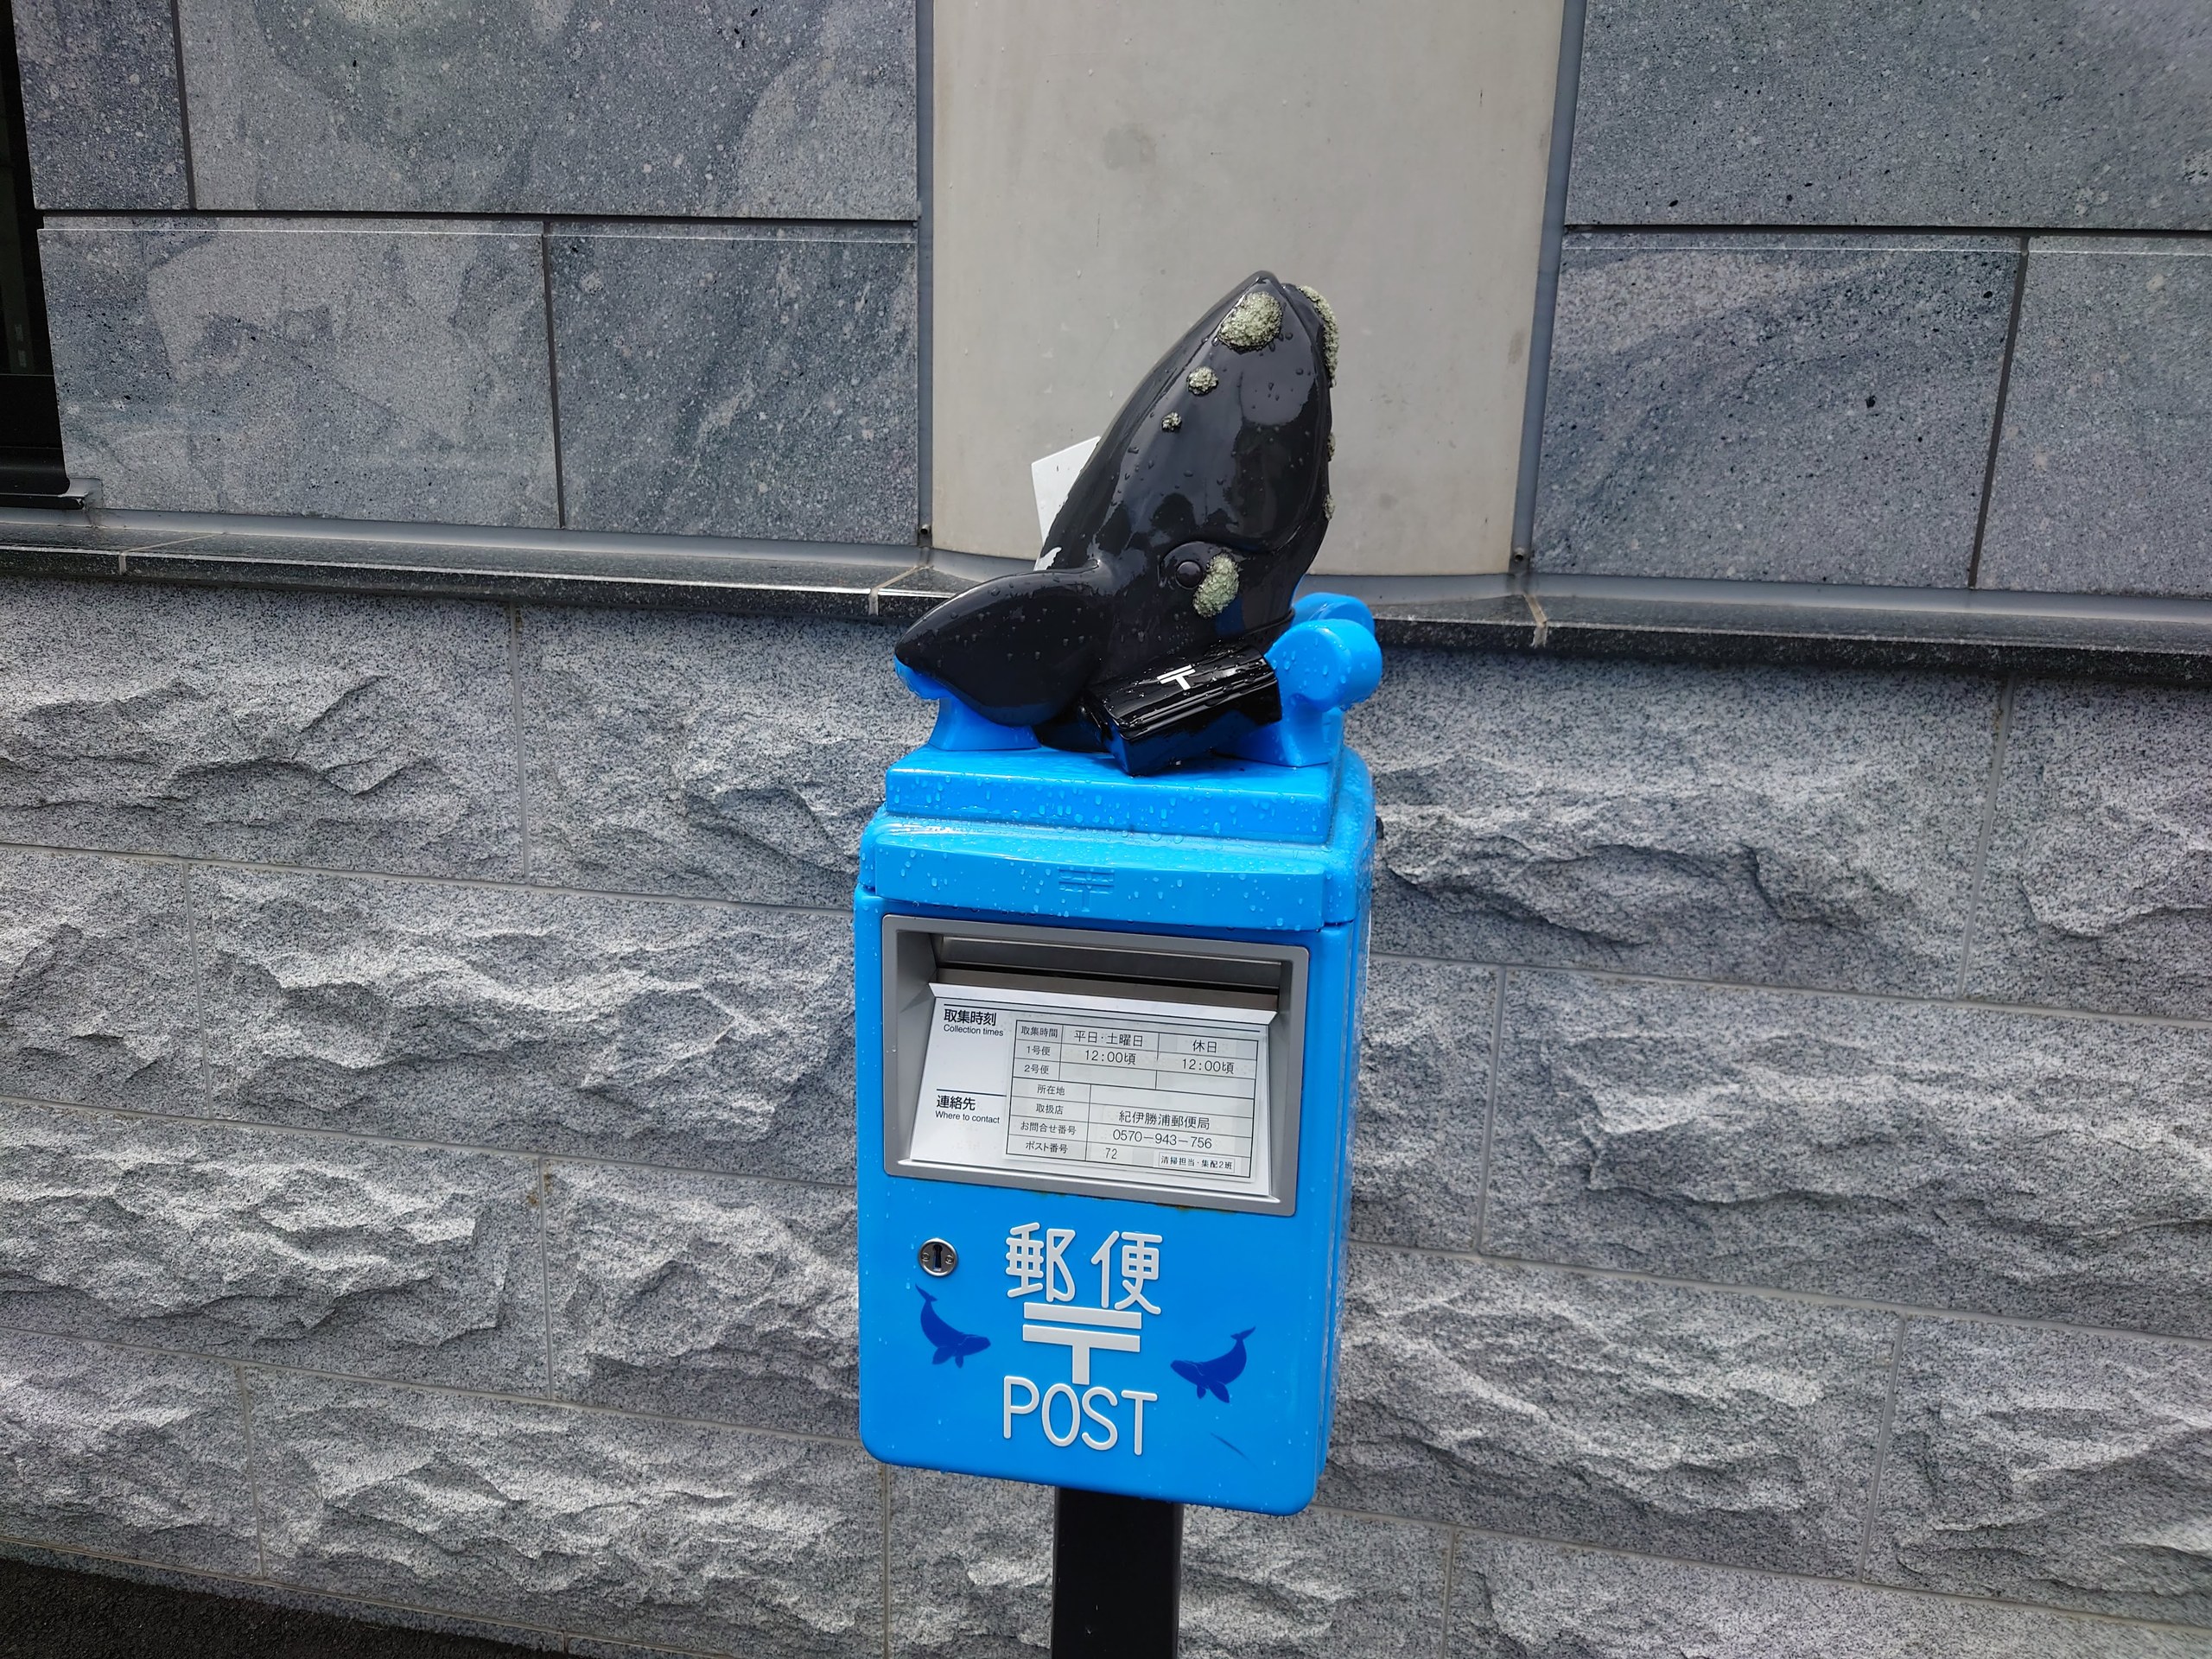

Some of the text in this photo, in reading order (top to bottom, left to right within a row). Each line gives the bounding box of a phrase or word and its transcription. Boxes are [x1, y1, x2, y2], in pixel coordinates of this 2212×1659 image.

[944, 1008, 997, 1027] 取集時刻
[944, 1024, 1004, 1037] Collection times
[1020, 1026, 1058, 1038] 取集時間
[1027, 1045, 1051, 1056] 1号便
[1192, 1039, 1217, 1053] 休日
[1084, 1050, 1136, 1065] 12:00頃
[1024, 1065, 1050, 1075] 2号便
[1182, 1058, 1235, 1074] 12:00頃
[1037, 1084, 1065, 1096] 所在地
[936, 1095, 976, 1111] 連絡先
[1036, 1103, 1064, 1115] 取扱店
[936, 1110, 960, 1121] Where
[971, 1115, 1000, 1123] contact
[1118, 1110, 1210, 1130] 紀伊勝浦郵便局
[1020, 1121, 1077, 1135] お問合せ番号
[1026, 1141, 1068, 1154] ポスト番号
[1105, 1147, 1118, 1160] 72
[1006, 1222, 1163, 1315] 郵便
[1003, 1375, 1158, 1455] POST
